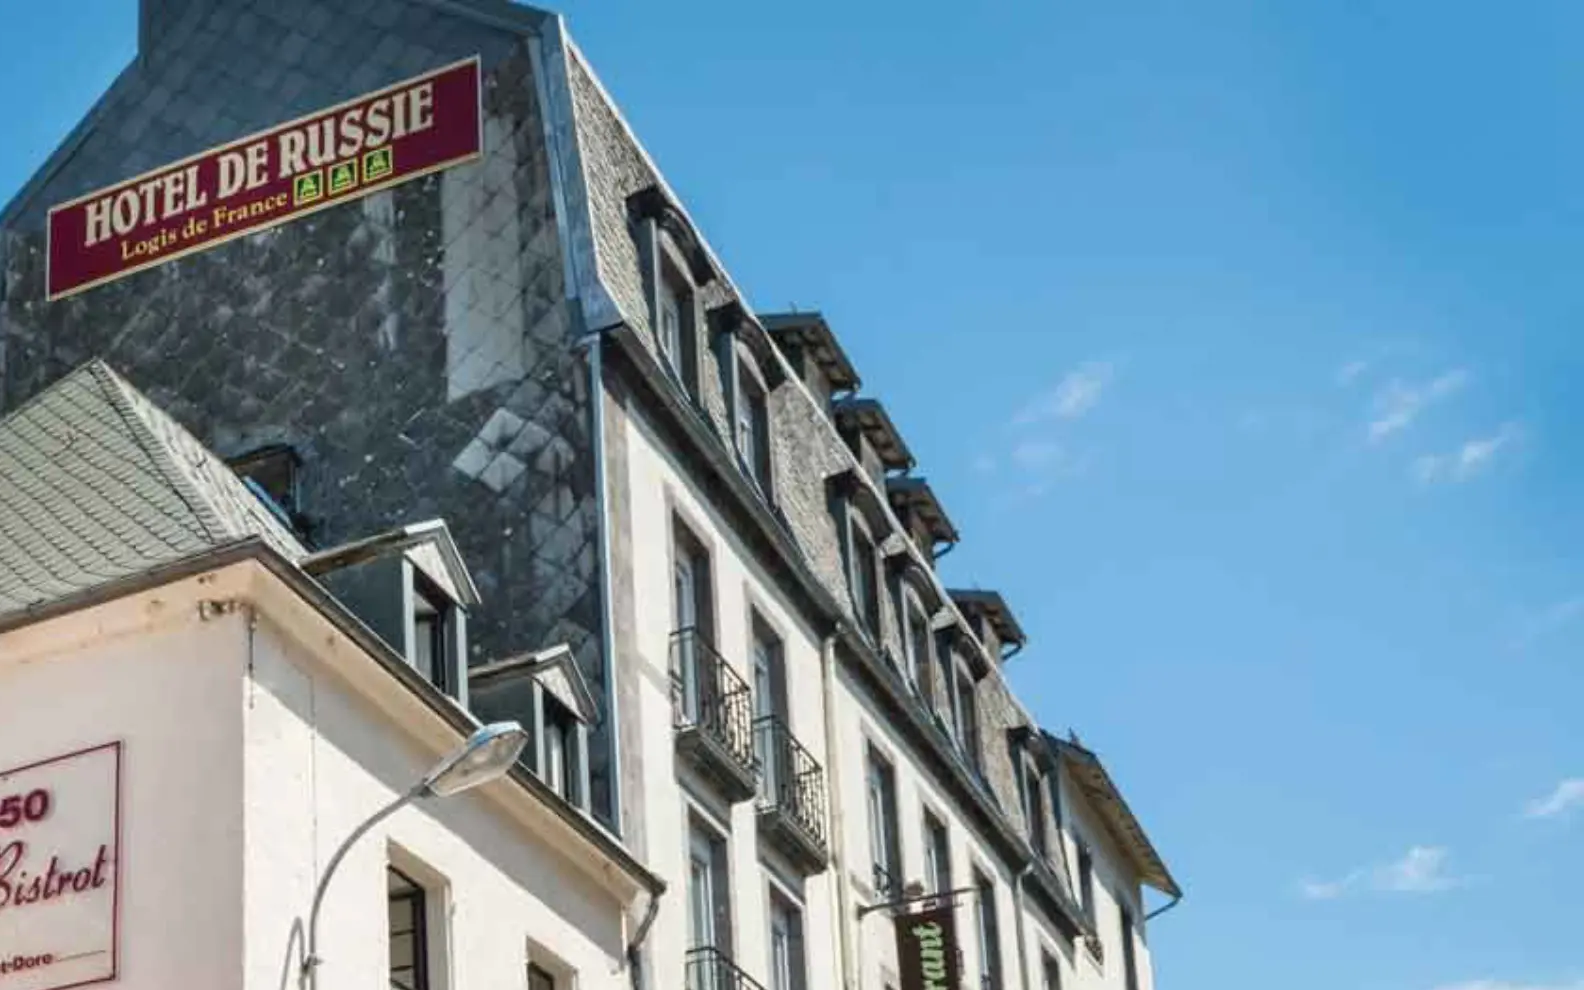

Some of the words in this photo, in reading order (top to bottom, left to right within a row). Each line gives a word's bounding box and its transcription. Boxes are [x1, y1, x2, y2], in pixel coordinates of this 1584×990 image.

[84, 170, 207, 247] HOTEL
[217, 145, 269, 199] DE
[278, 83, 434, 178] RUSSIE
[121, 225, 178, 261] Logis
[182, 213, 208, 239] de
[213, 191, 288, 229] France
